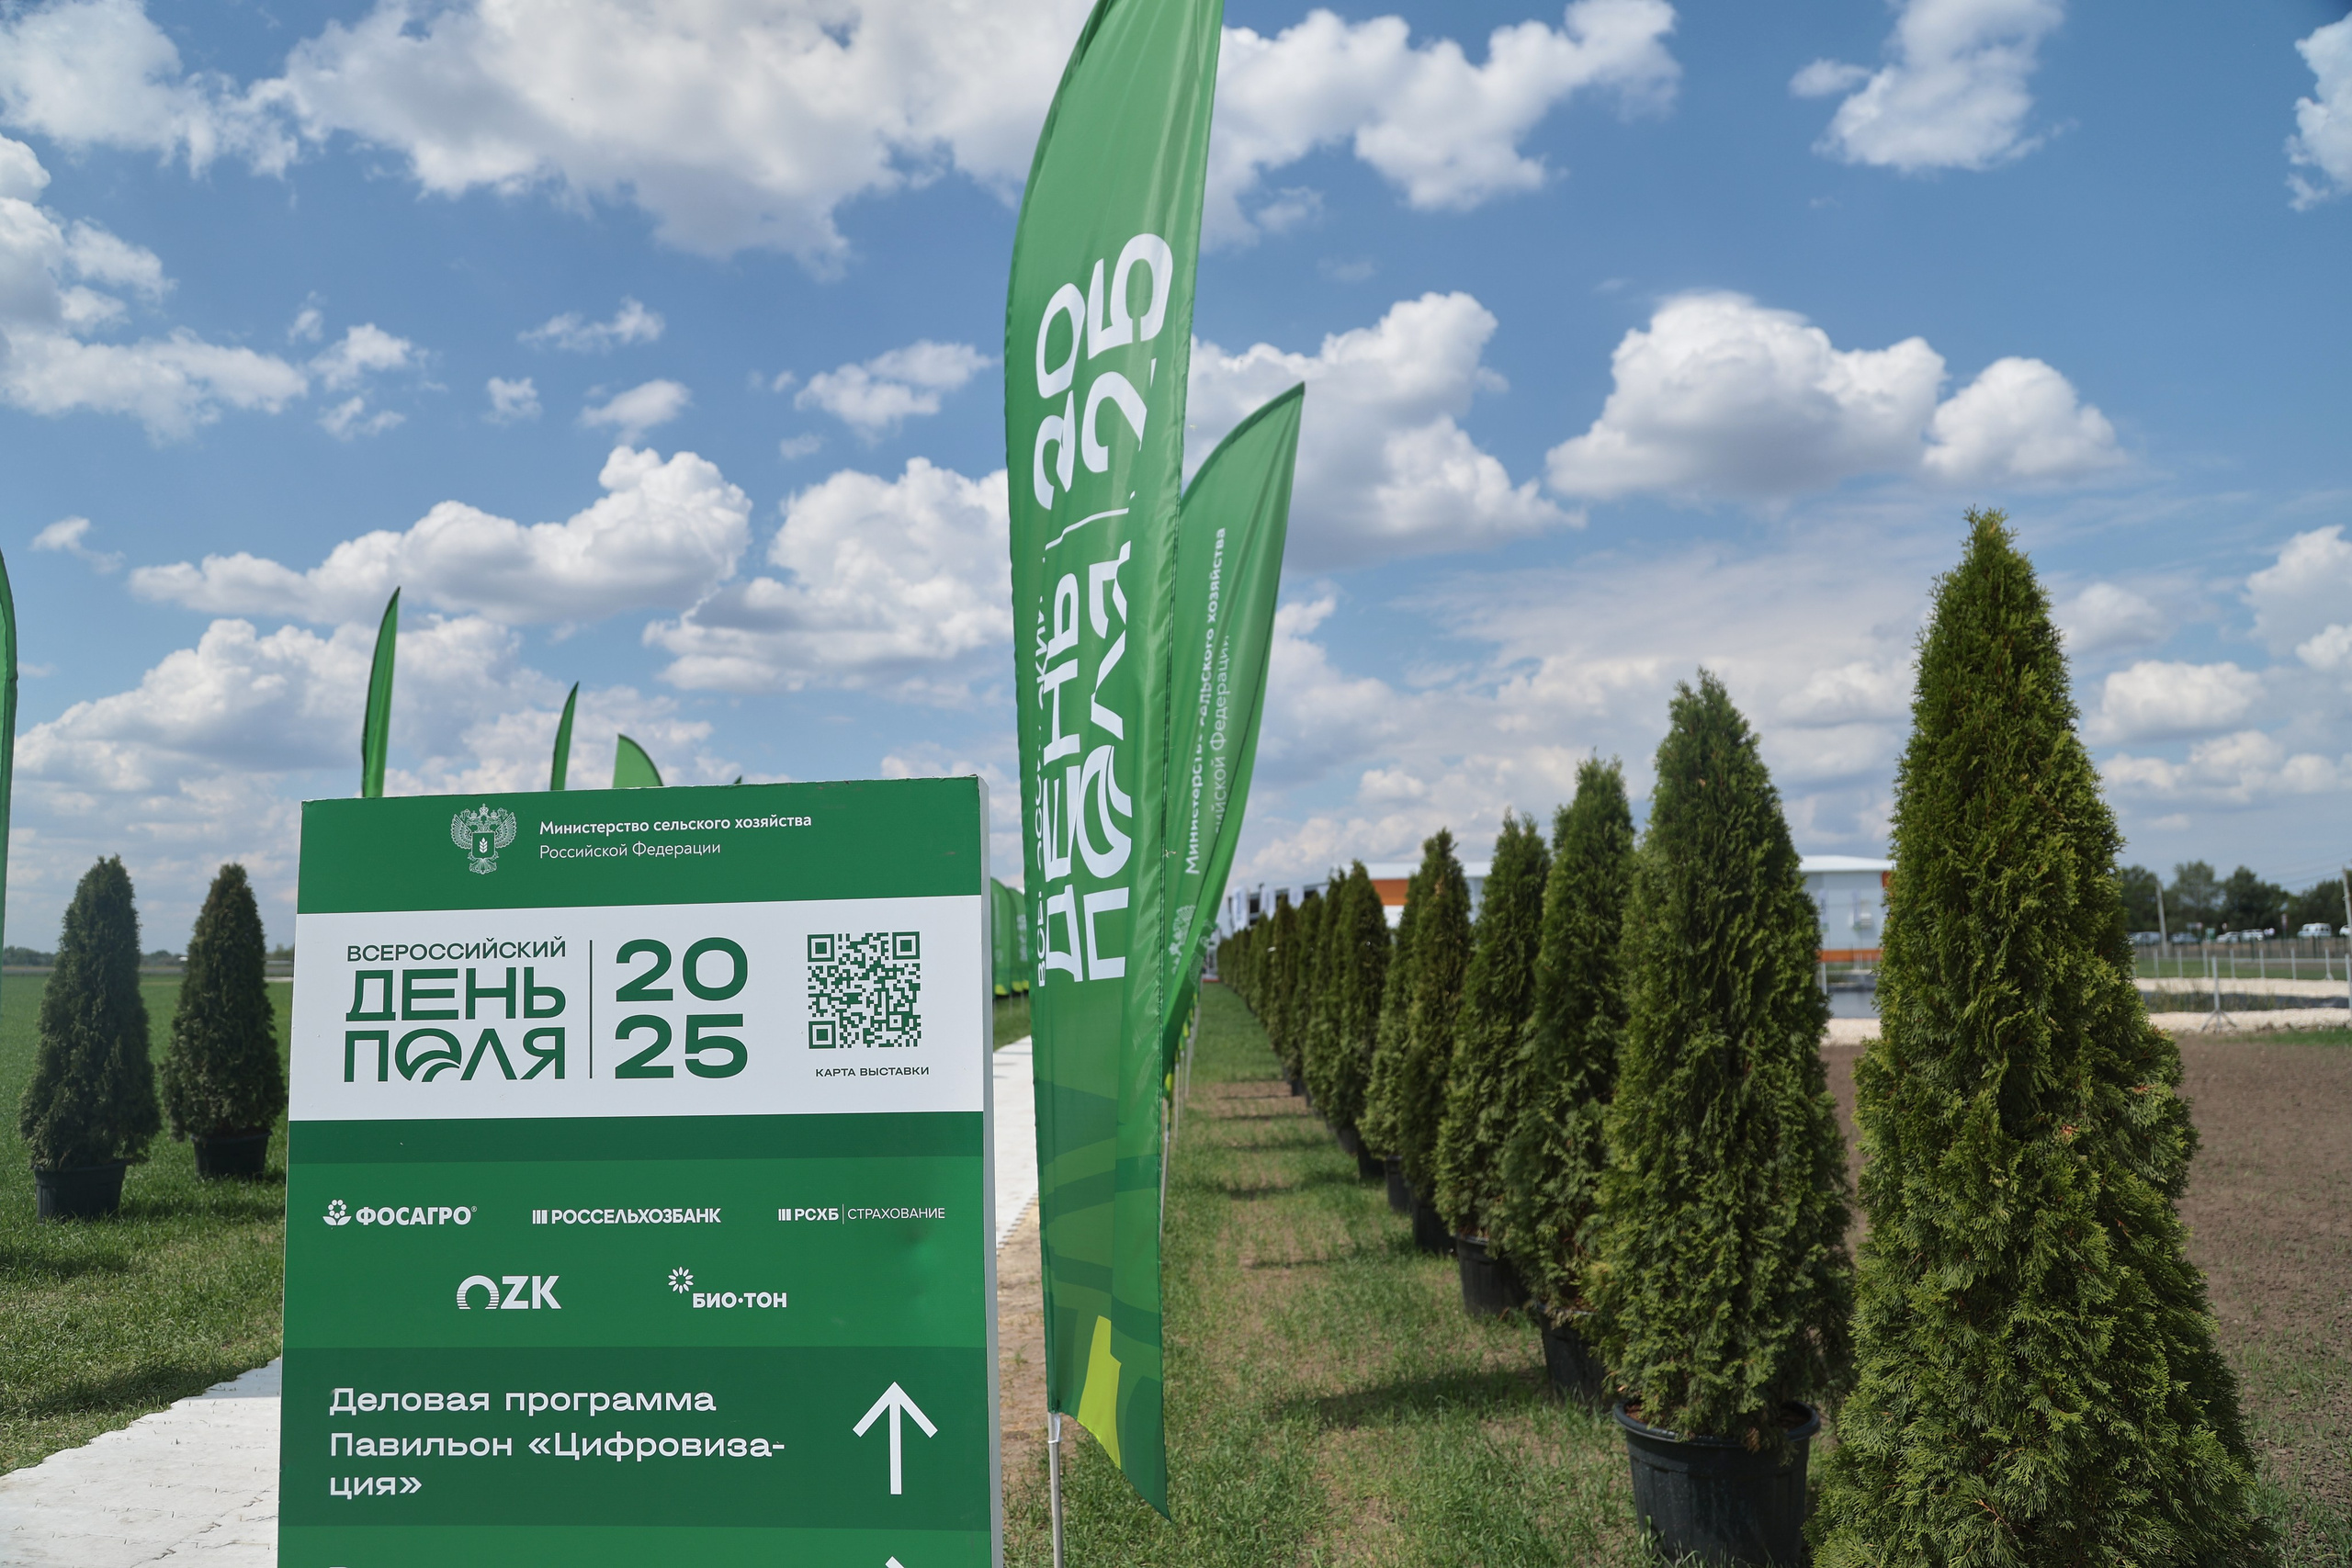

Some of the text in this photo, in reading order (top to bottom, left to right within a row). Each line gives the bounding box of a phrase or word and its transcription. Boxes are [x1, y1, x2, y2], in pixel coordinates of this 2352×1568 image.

[1081, 233, 1173, 473] 25
[1034, 283, 1086, 511] 20
[1207, 527, 1227, 624] хозяйства
[1043, 572, 1083, 983] ДЕНЬ
[539, 814, 812, 837] Министерство сельского хозяйства
[539, 840, 721, 859] Российской Федерации
[346, 935, 566, 963] ВСЕРОССИЙСКИЙ
[616, 936, 749, 1002] 20
[345, 966, 566, 1022] ДЕНЬ
[344, 1026, 566, 1083] ПОЛЯ
[615, 1013, 748, 1079] 25
[815, 1066, 930, 1078] КАРТА ВЫСТАВКИ
[551, 1207, 722, 1225] РОССЕЛЬХОЗБАНК
[794, 1207, 945, 1222] РСХБ СТРАХОВАНИЕ
[329, 1387, 717, 1417] Деловая программа
[330, 1430, 786, 1462] Павильон «Цифровиза-
[329, 1476, 423, 1500] ция»
